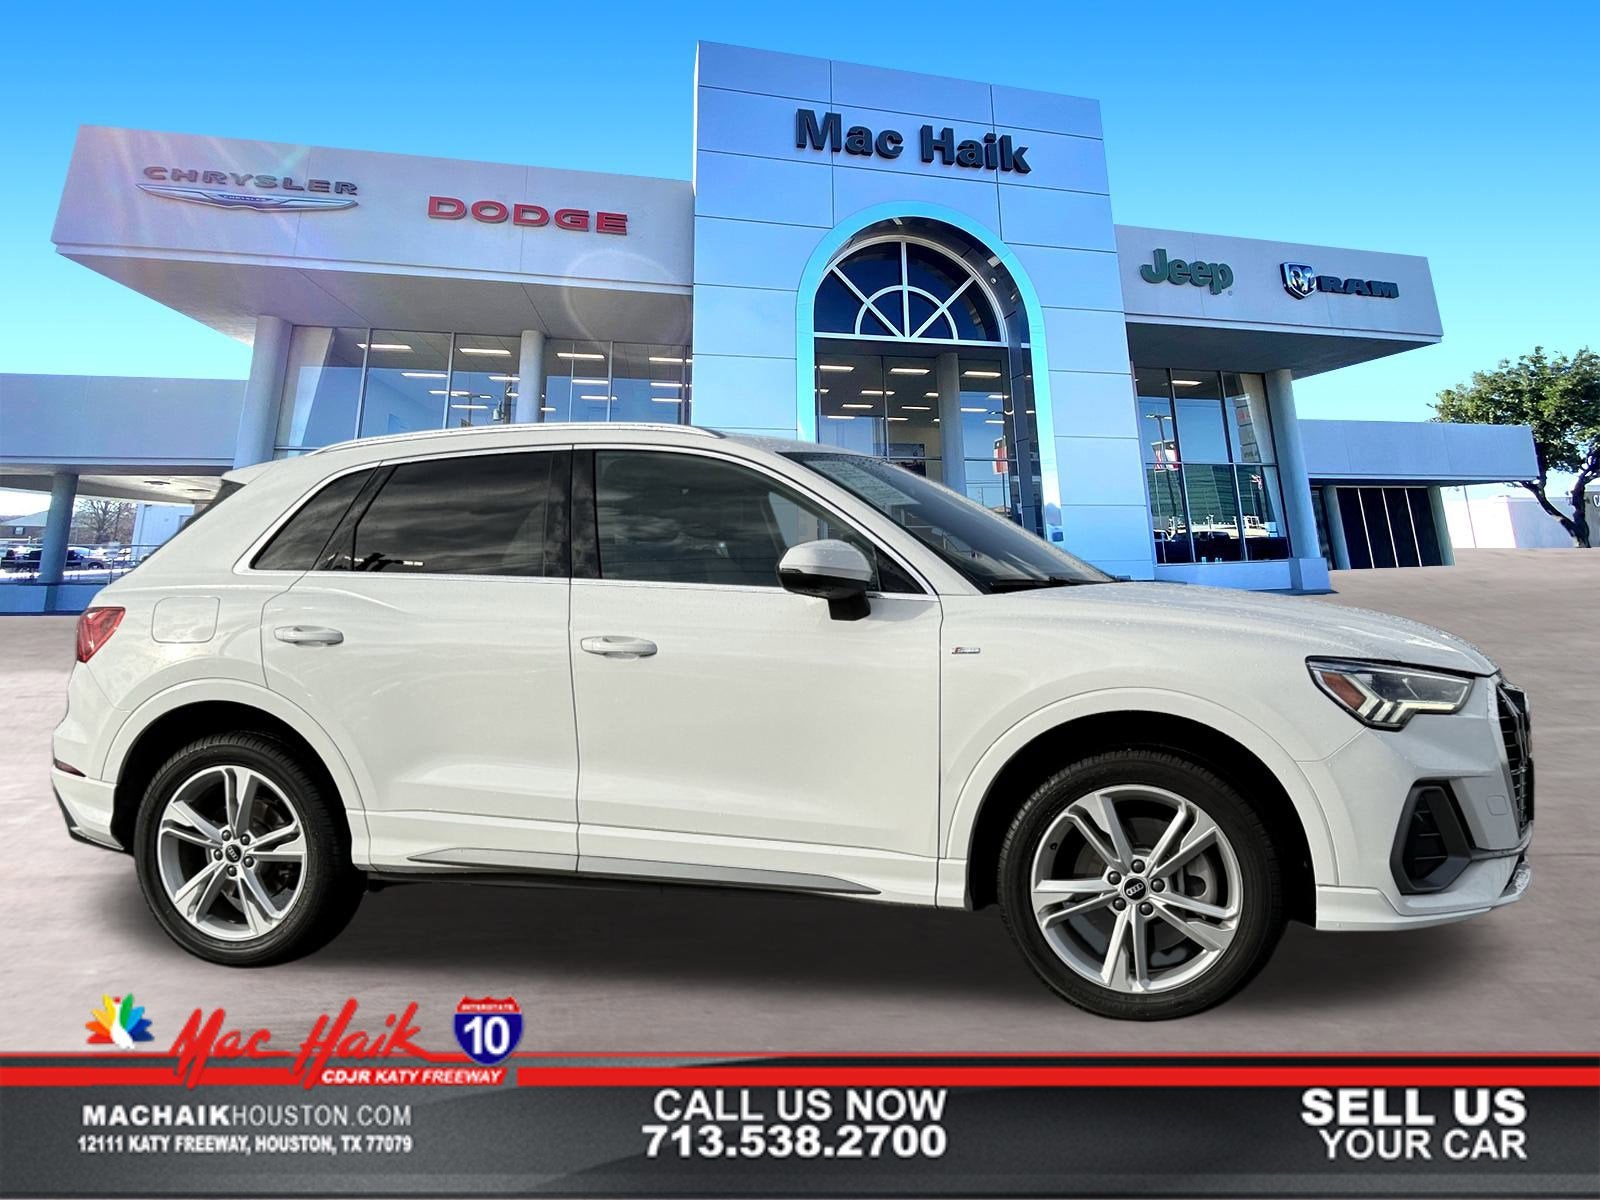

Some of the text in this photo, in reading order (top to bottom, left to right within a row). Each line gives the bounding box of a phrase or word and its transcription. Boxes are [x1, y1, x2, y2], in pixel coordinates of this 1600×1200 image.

[795, 108, 1032, 174] Mac Haik
[143, 166, 358, 196] CHRYSLER
[428, 196, 628, 236] DODGE
[1140, 248, 1234, 295] Jeep
[1316, 275, 1400, 299] RAM
